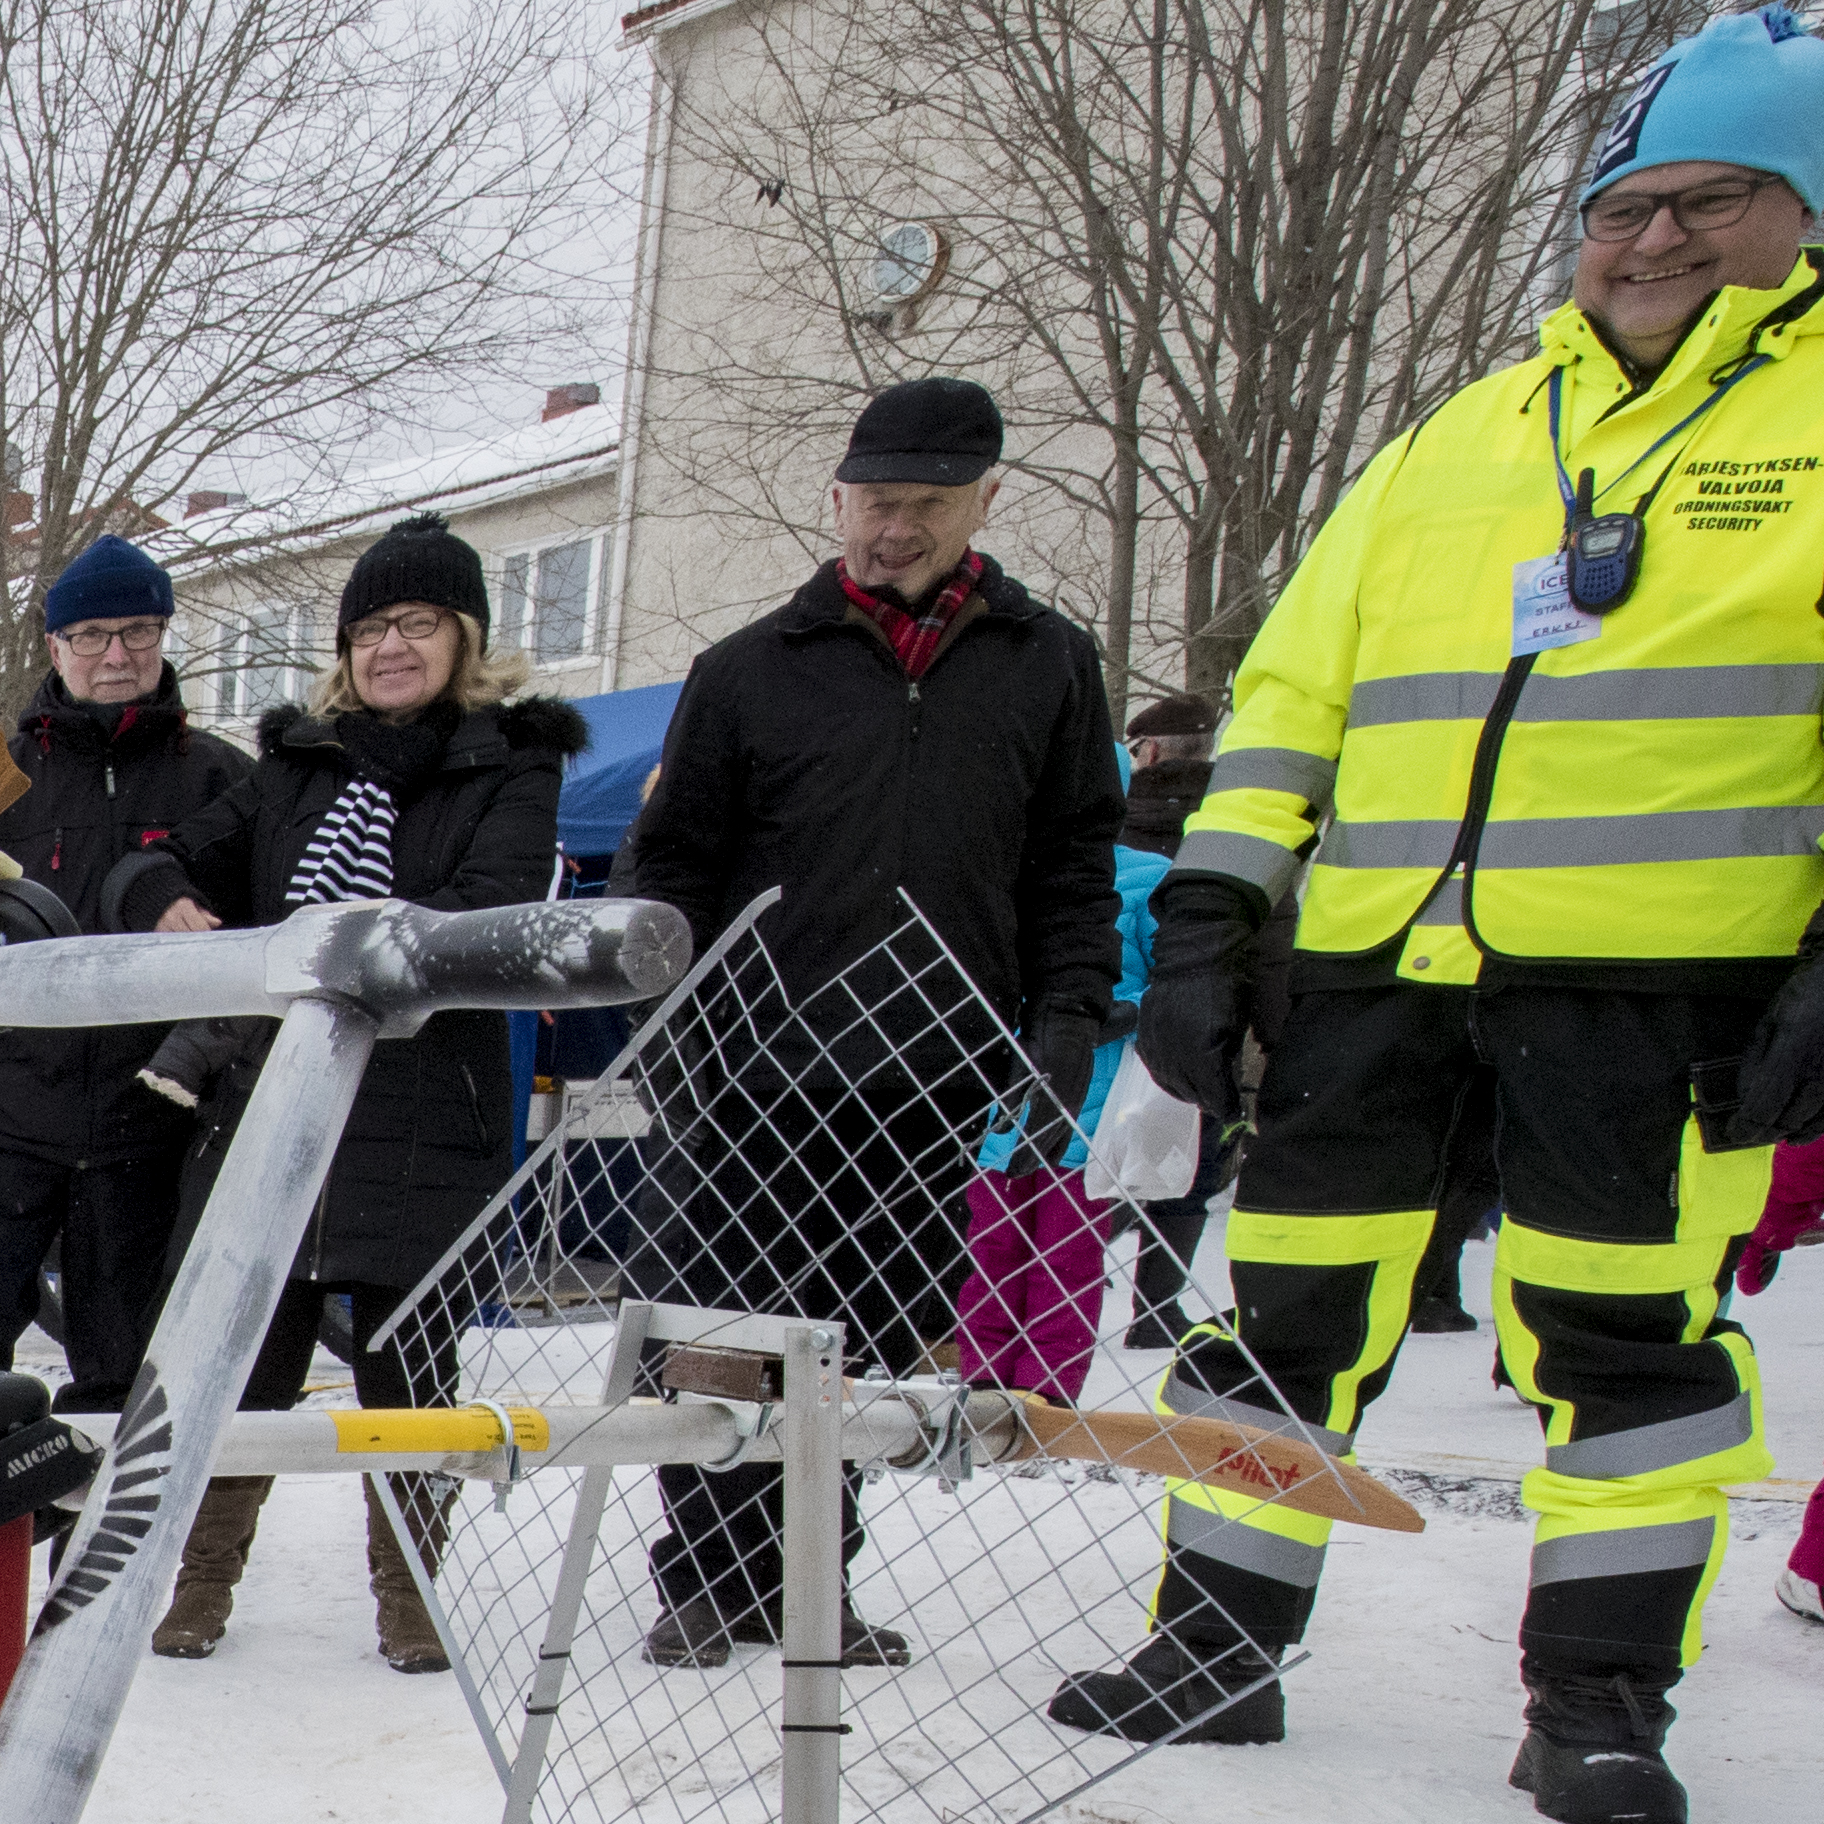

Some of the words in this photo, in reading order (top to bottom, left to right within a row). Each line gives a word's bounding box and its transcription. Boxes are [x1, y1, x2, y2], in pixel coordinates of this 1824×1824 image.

[1698, 478, 1784, 495] VALVOJA
[1673, 499, 1793, 514] ORDNINGSVAKT
[1687, 516, 1763, 531] SECURITY
[7, 1434, 69, 1479] MICRO
[1214, 1447, 1300, 1490] Pilot
